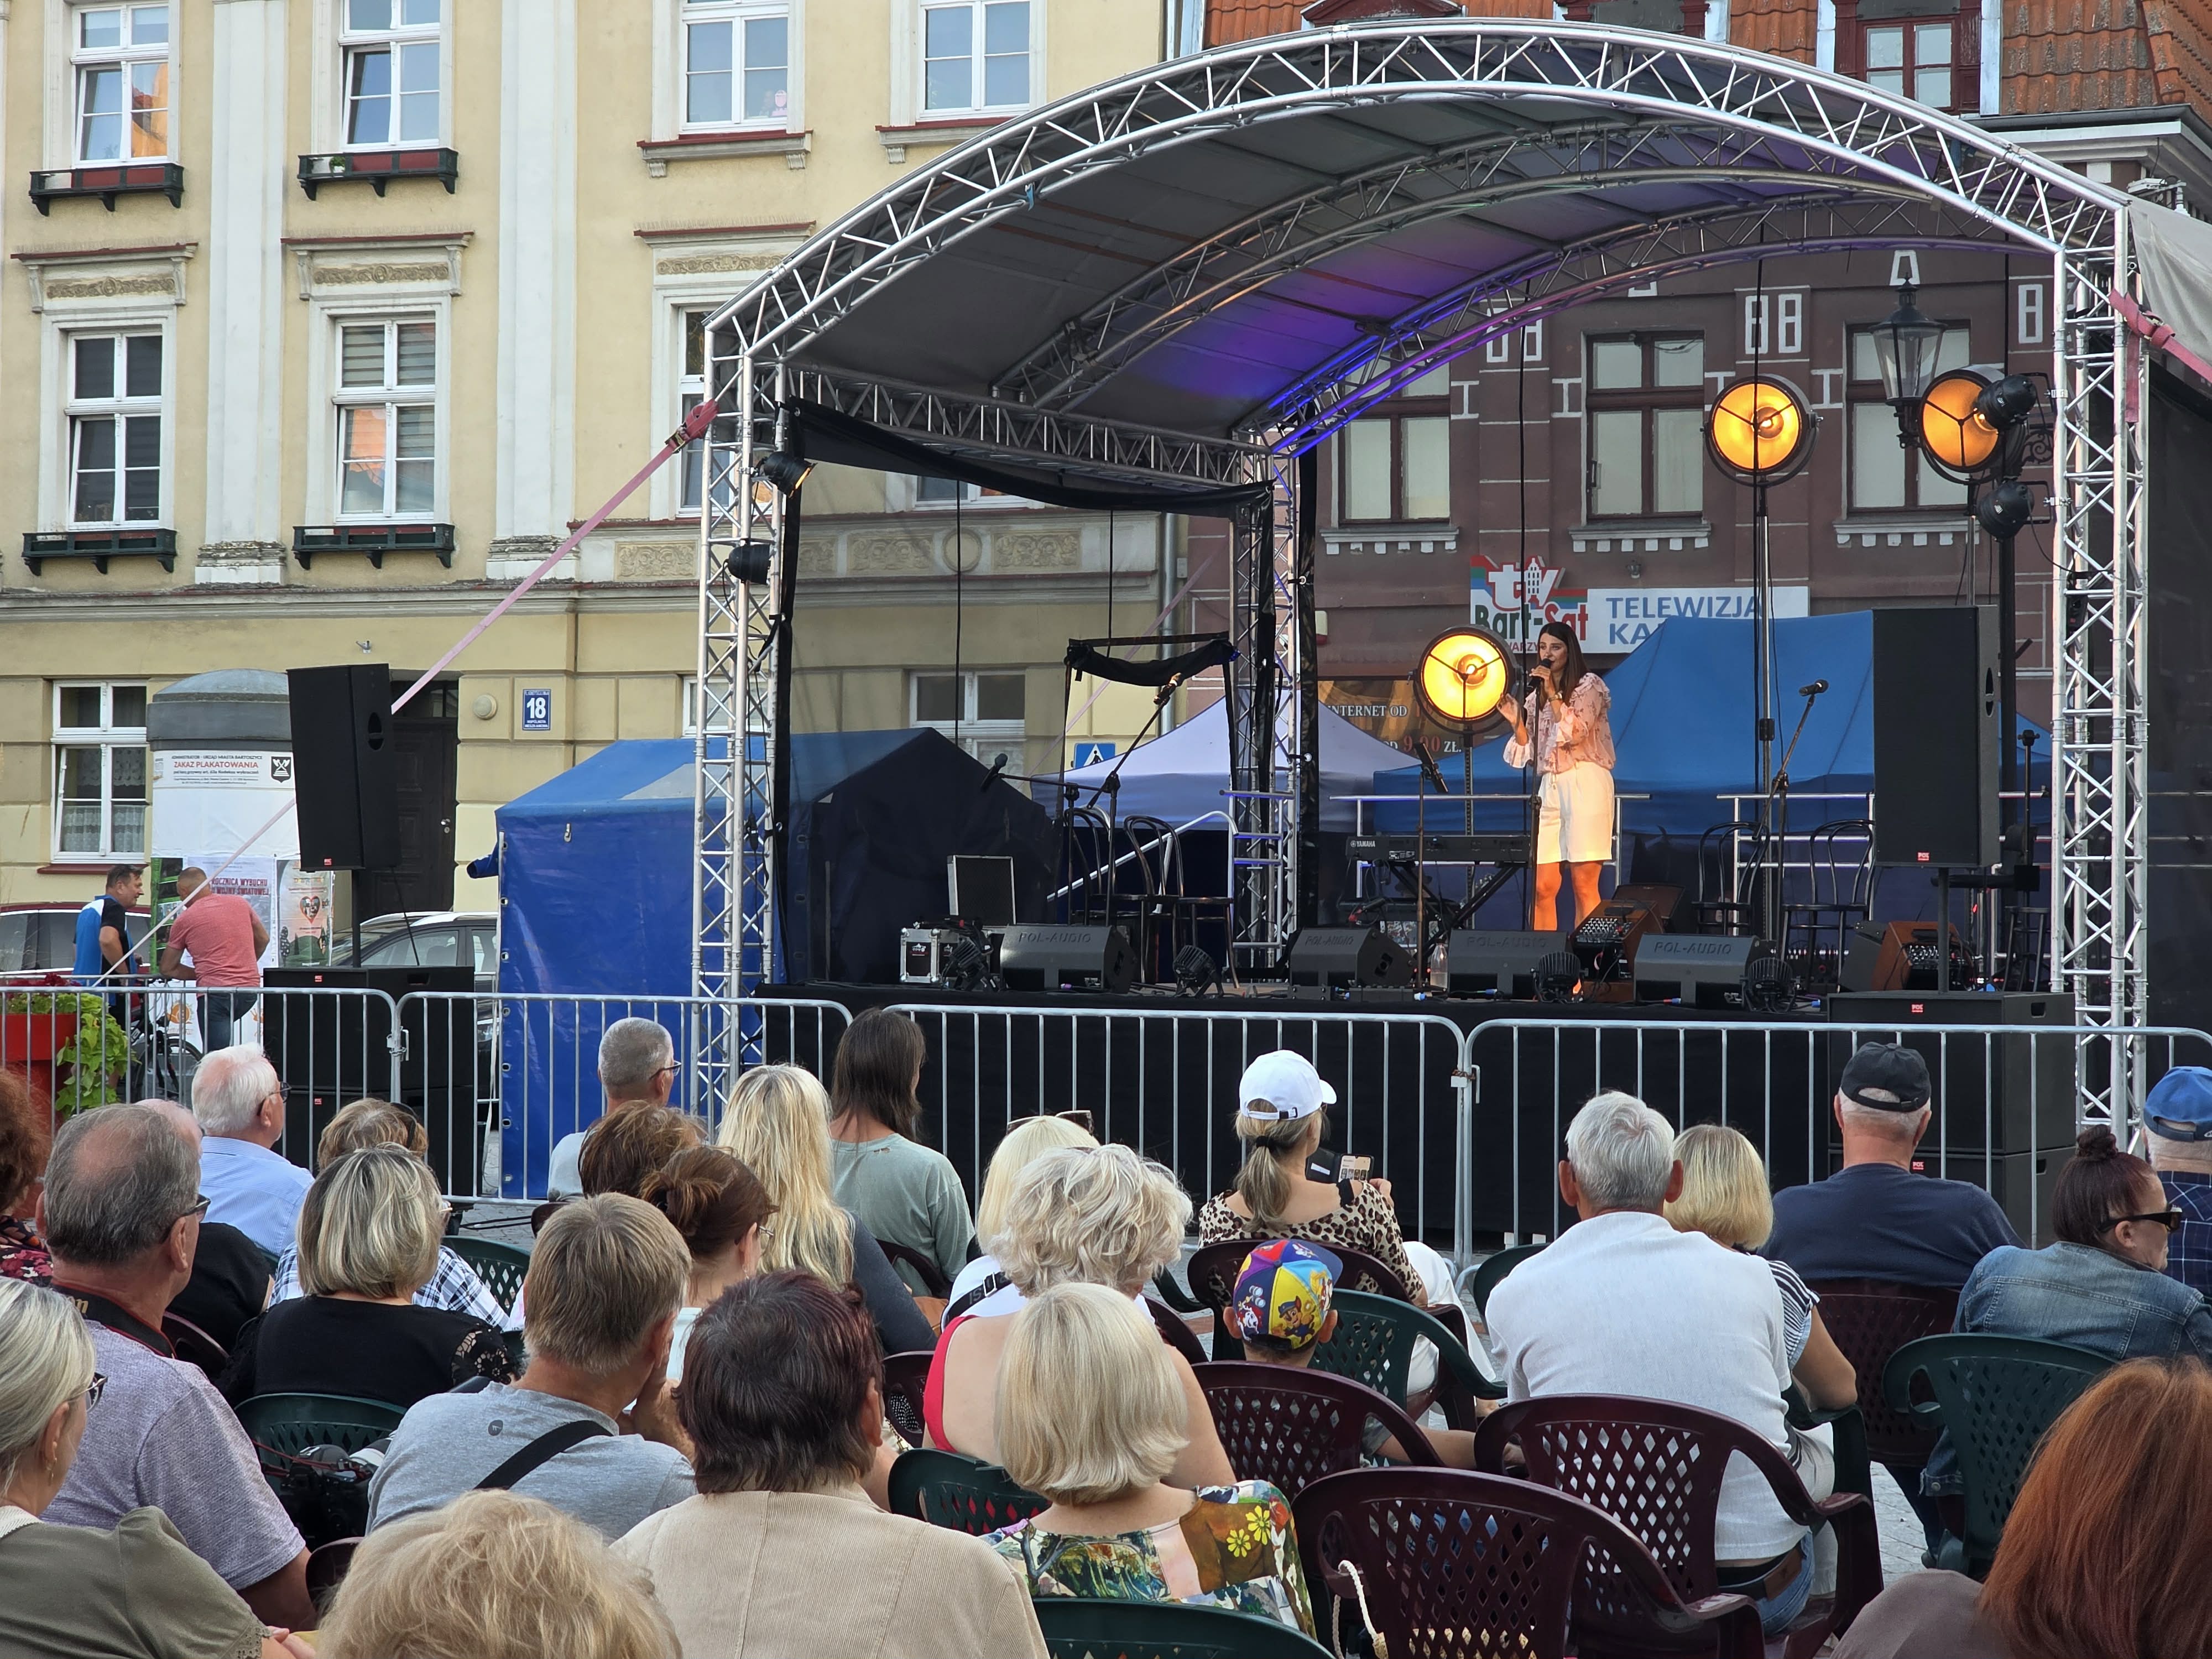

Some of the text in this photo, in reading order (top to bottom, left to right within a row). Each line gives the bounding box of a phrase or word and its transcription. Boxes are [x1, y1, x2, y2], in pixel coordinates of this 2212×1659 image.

[1605, 596, 1764, 619] TELEWIZJA
[1609, 623, 1662, 645] KA
[526, 697, 546, 718] 18
[1328, 705, 1386, 717] NTERNET
[1390, 705, 1408, 717] OD
[240, 878, 268, 886] WYBUCHU
[237, 885, 269, 895] ŚWIATOWEJ
[1019, 932, 1092, 943] POL-AUDIO
[1654, 942, 1731, 955] POL-AUDIO
